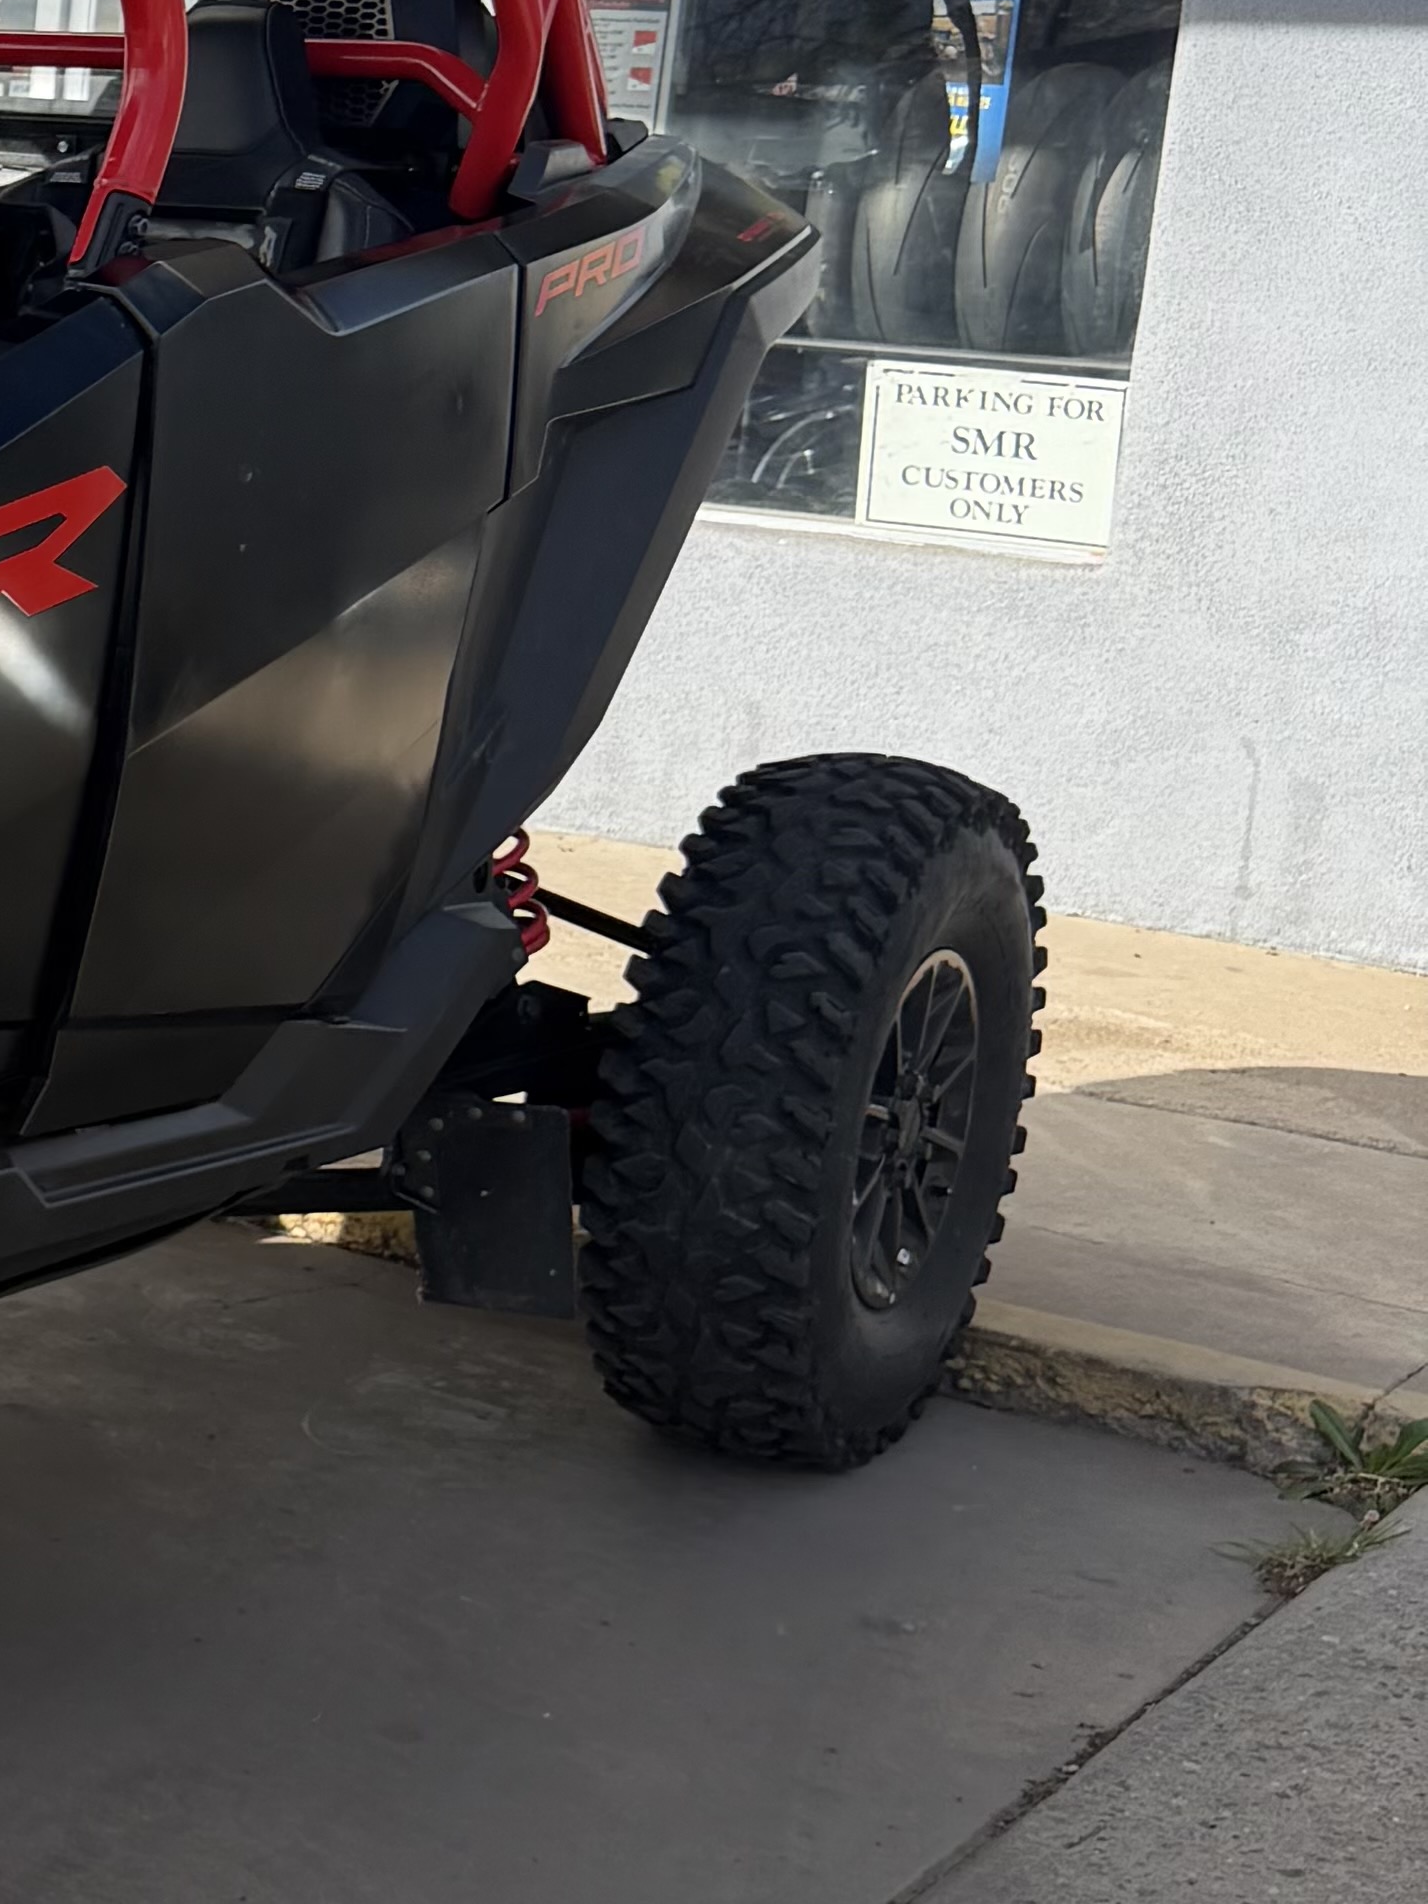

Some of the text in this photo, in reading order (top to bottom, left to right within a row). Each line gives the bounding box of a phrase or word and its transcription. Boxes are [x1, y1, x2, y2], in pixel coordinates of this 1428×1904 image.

[534, 225, 645, 318] PRO
[896, 383, 1105, 422] PARKING FOR
[951, 425, 1038, 461] SMR
[901, 464, 1084, 503] CUSTOMERS
[949, 497, 1030, 525] ONLY
